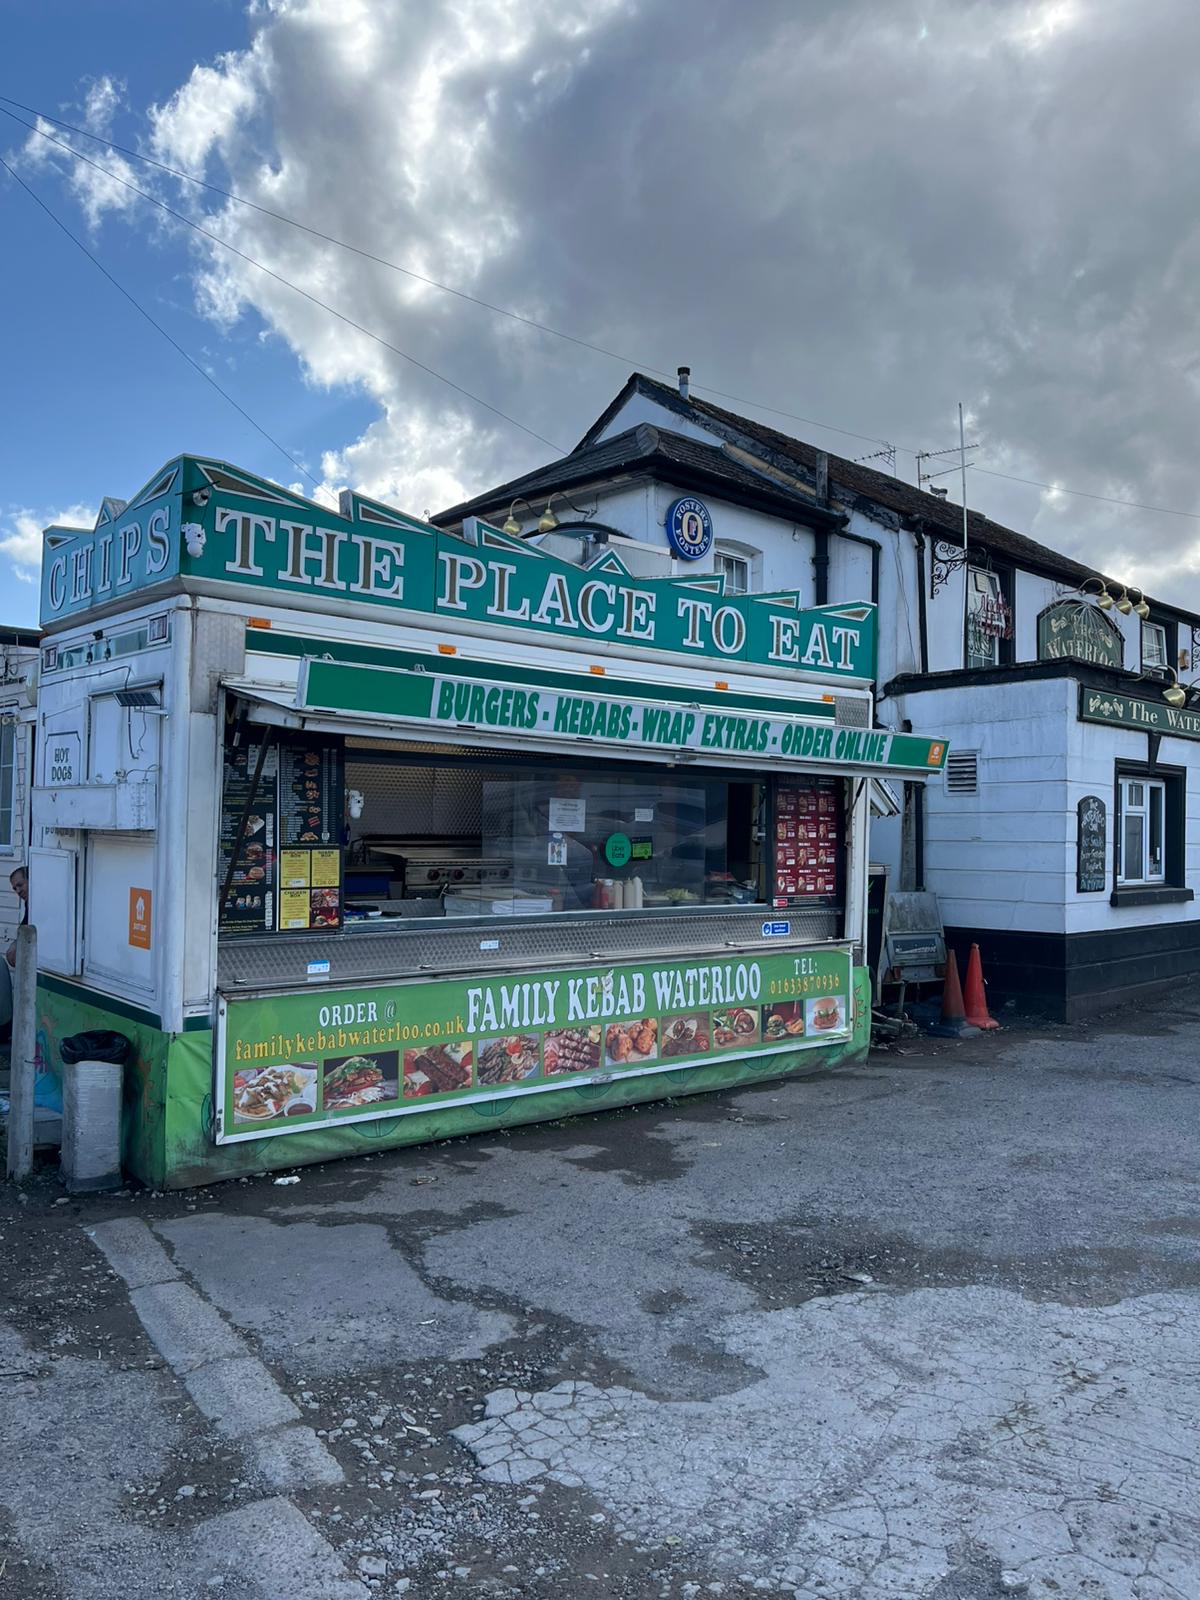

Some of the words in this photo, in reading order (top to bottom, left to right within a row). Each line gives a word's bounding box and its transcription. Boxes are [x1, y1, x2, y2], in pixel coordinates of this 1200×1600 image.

[50, 505, 170, 611] CHIPS
[215, 506, 405, 600] THE
[437, 551, 656, 641] PLACE
[678, 597, 746, 654] TO
[768, 615, 860, 670] EAT
[437, 681, 540, 729] BURGERS
[553, 696, 632, 739] KEBABS
[642, 708, 695, 745] WRAP
[701, 714, 770, 751] EXTRAS
[781, 723, 833, 760] ORDER
[835, 730, 887, 763] ONLINE
[1129, 701, 1158, 724] The
[1166, 709, 1200, 732] WATE
[51, 766, 72, 781] DOGS
[54, 748, 70, 763] HOT
[794, 957, 818, 975] TEL:
[319, 1001, 378, 1027] ORDER
[384, 1000, 397, 1024] @
[467, 980, 560, 1033] FAMILY
[567, 972, 646, 1021] KEBAB
[652, 963, 761, 1011] WATERLOO
[235, 1015, 465, 1060] familykebabwaterloo.co.uk
